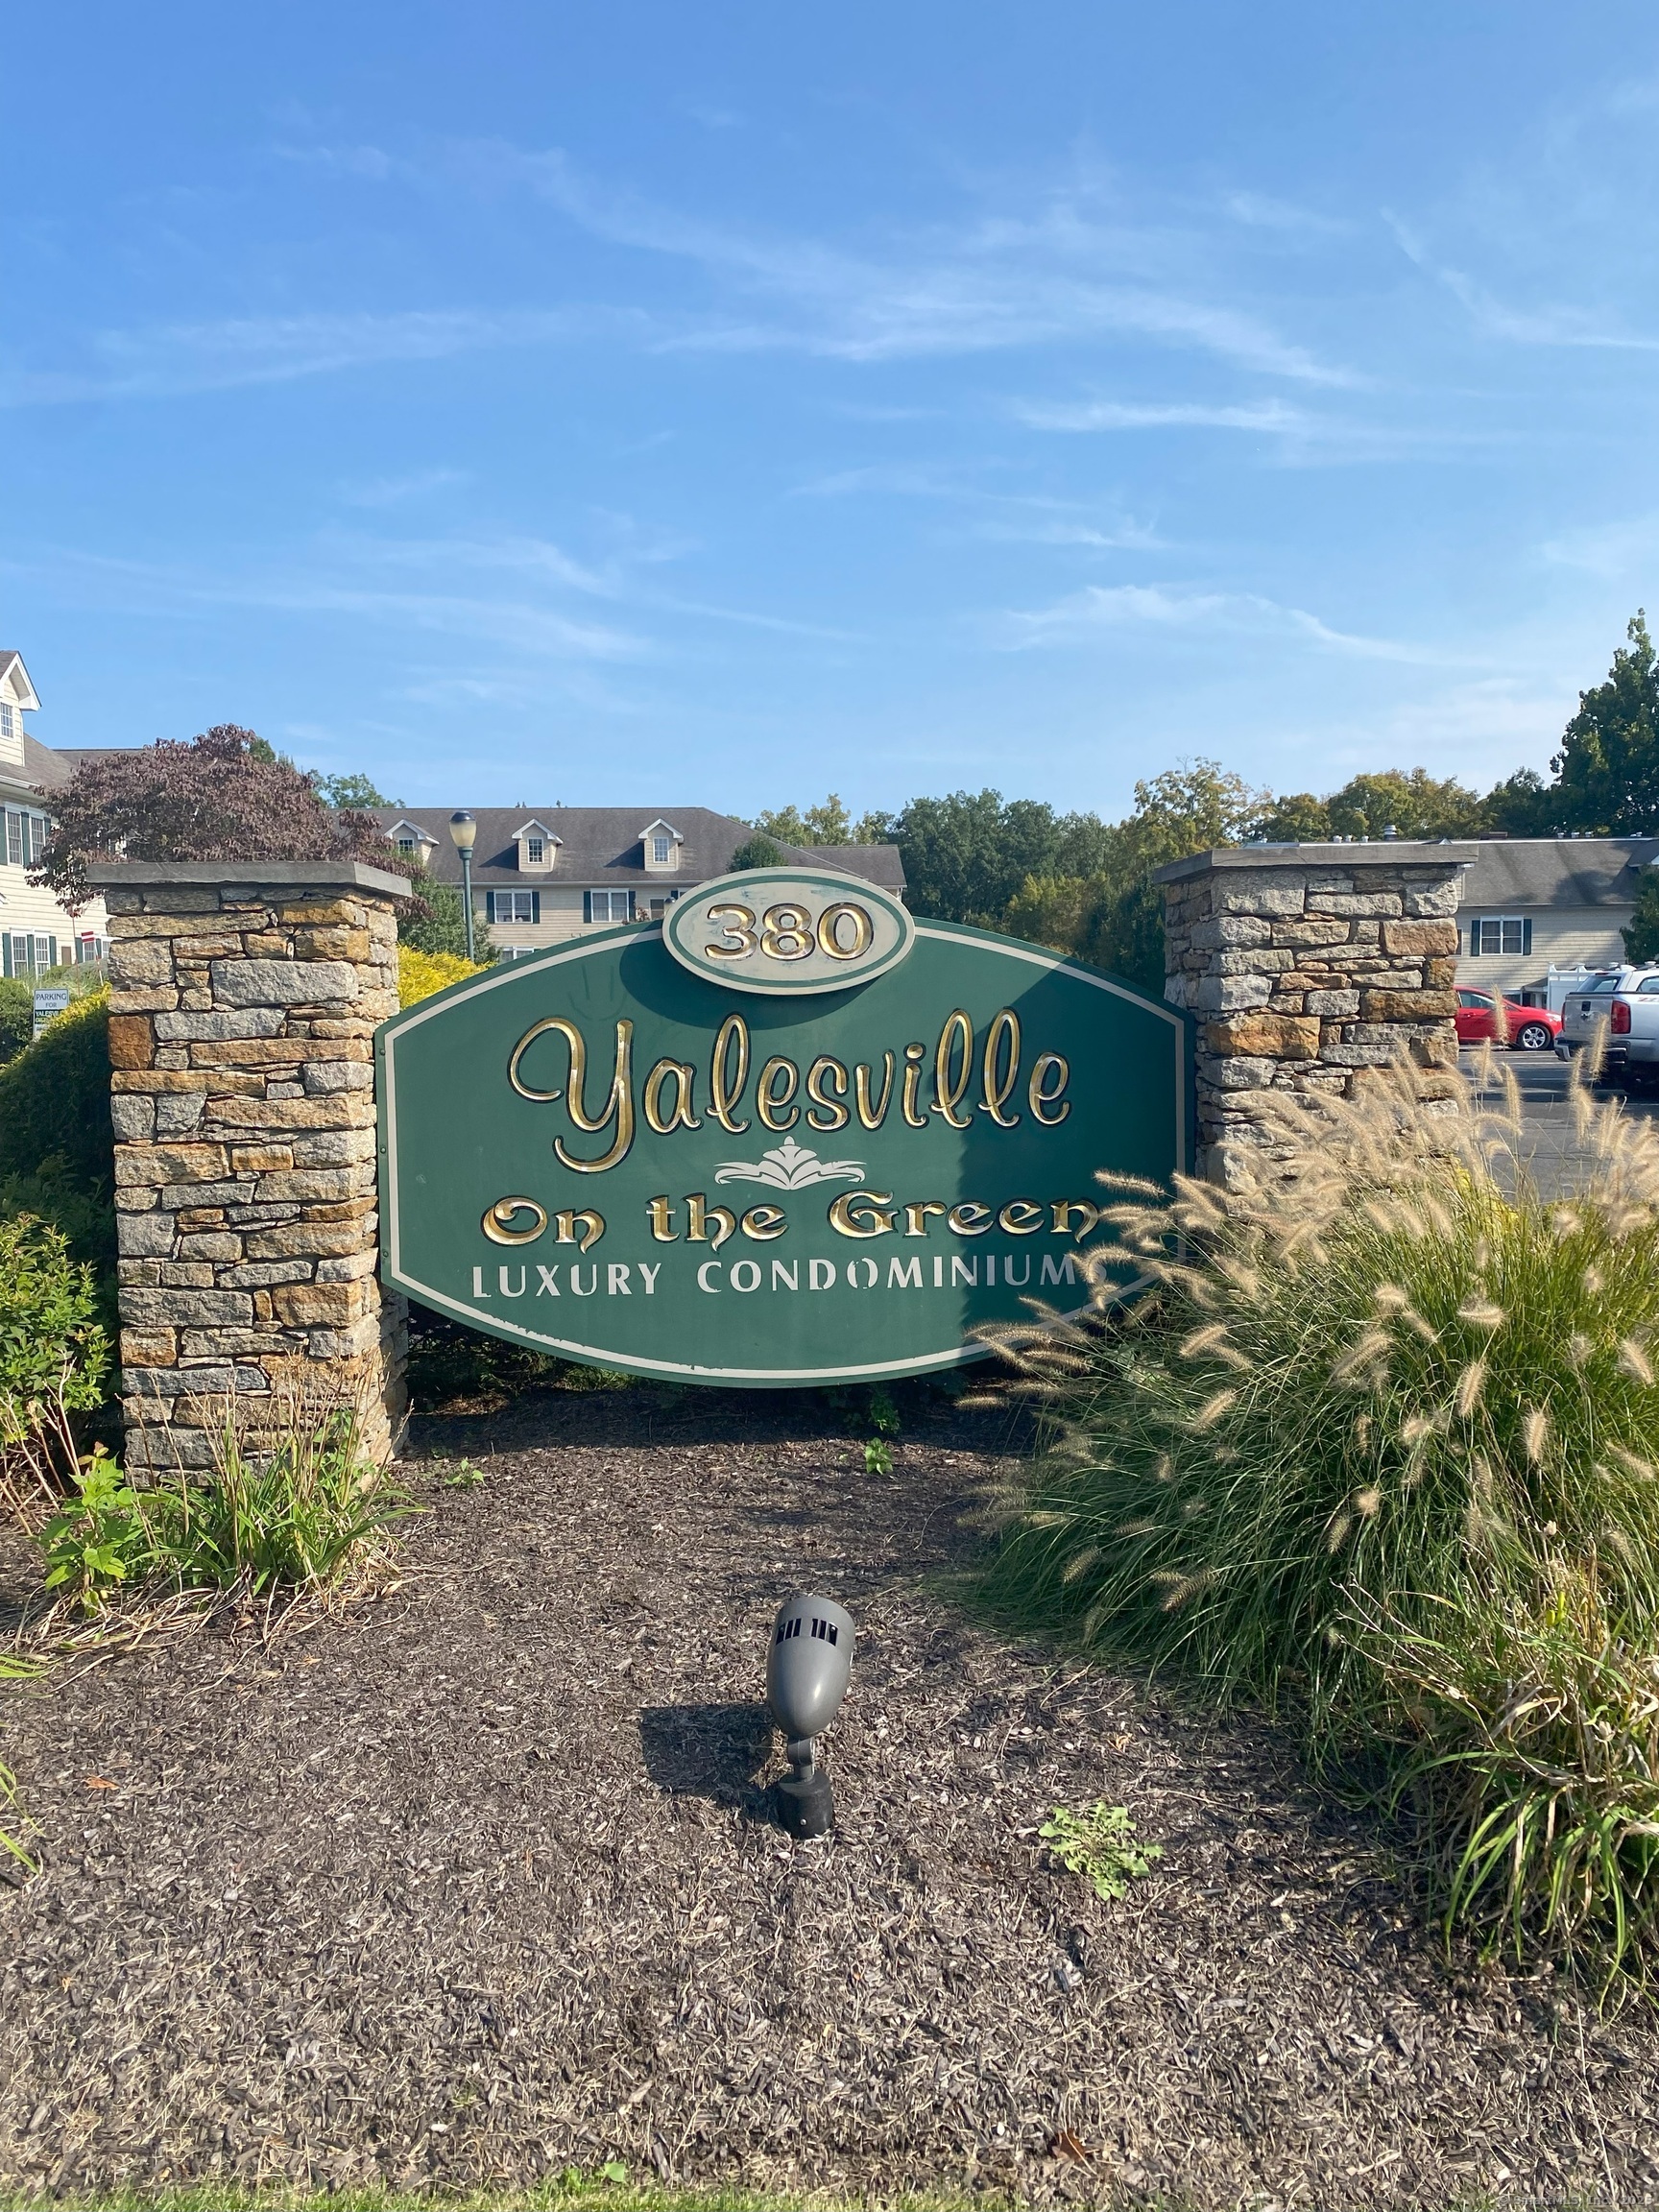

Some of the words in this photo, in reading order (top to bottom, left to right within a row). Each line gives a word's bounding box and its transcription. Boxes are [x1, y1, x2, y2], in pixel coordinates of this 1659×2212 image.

[705, 902, 875, 961] 380
[508, 1007, 1071, 1174] Yalesville
[480, 1194, 607, 1254] On
[645, 1191, 788, 1254] the
[829, 1189, 1100, 1243] Green
[472, 1262, 661, 1298] LUXURY
